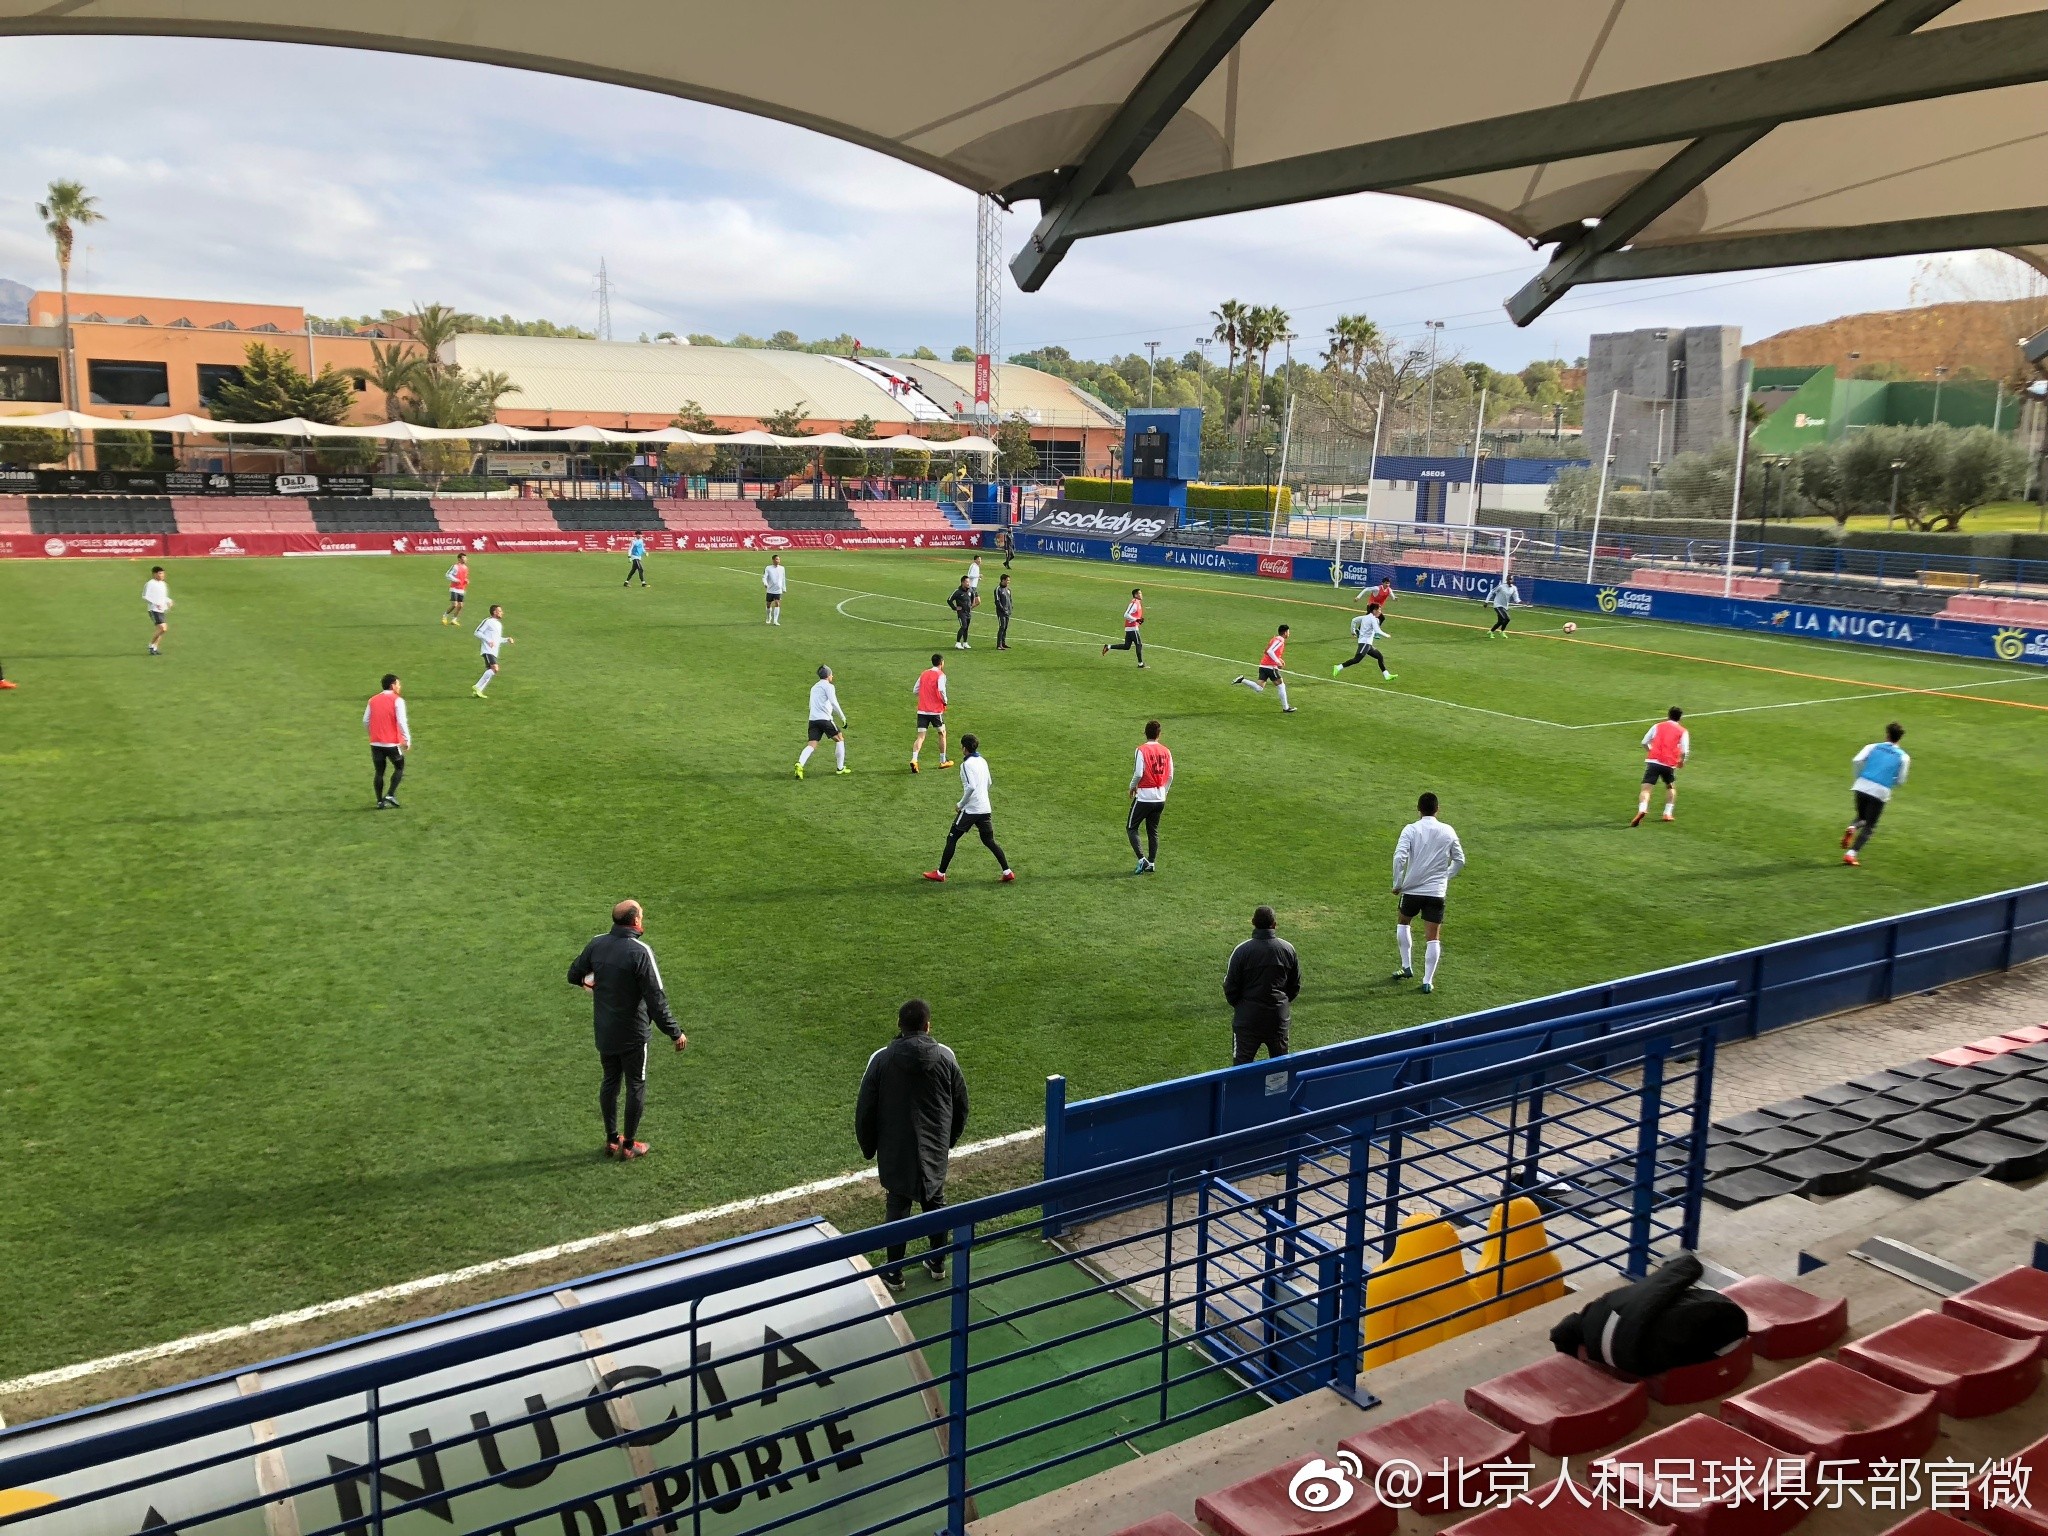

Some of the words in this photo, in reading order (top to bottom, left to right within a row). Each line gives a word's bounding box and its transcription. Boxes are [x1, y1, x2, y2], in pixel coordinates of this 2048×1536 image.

[280, 476, 306, 487] D&D
[65, 539, 102, 547] HOTELES
[103, 538, 157, 547] SERVIGROUP
[1045, 539, 1055, 552] LA
[1175, 551, 1187, 564] LA
[1343, 570, 1367, 581] Blanca
[1348, 564, 1368, 575] Costa
[1430, 573, 1447, 589] LA
[1623, 591, 1652, 603] Costa
[1617, 598, 1651, 611] Blanca
[1794, 611, 1820, 631] LA
